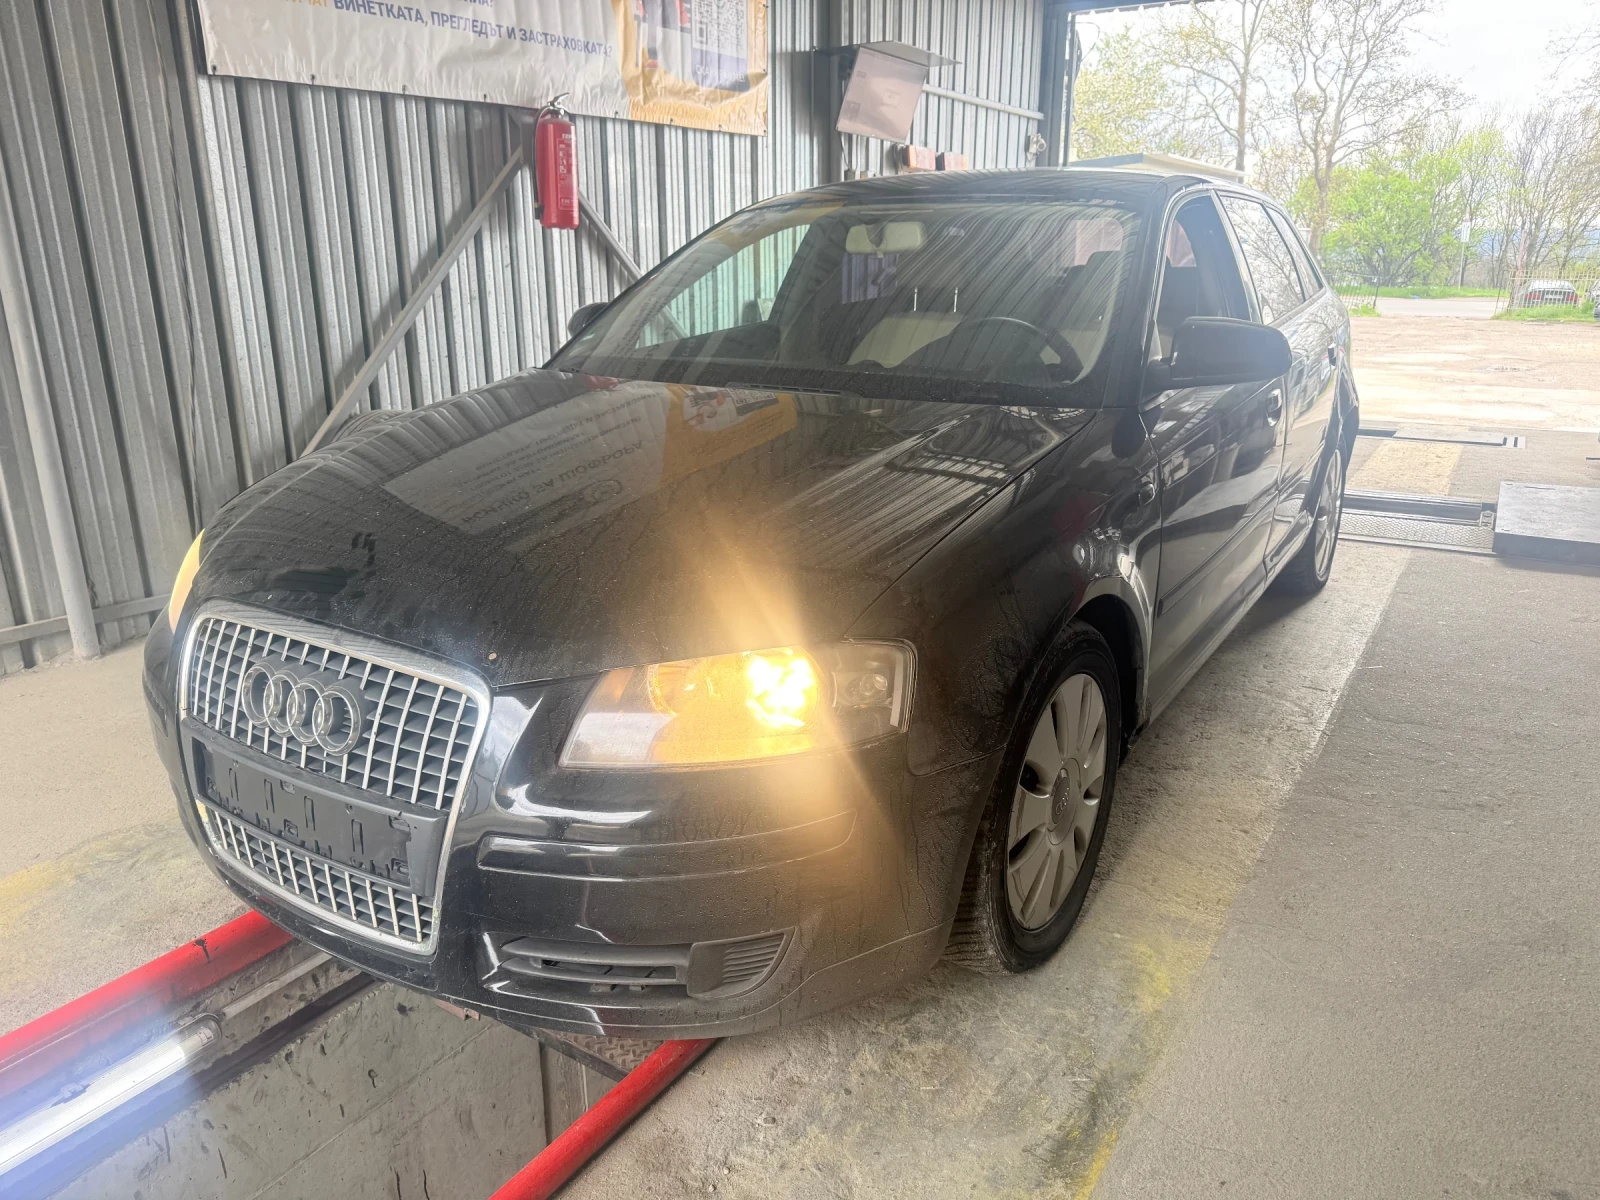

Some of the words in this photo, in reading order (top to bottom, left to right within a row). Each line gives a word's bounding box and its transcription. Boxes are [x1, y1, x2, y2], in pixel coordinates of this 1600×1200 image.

[431, 11, 504, 38] ПРЕГЛЕДЪТ
[506, 26, 517, 40] И
[519, 28, 613, 57] ЗАСТРАХОВКАТА?
